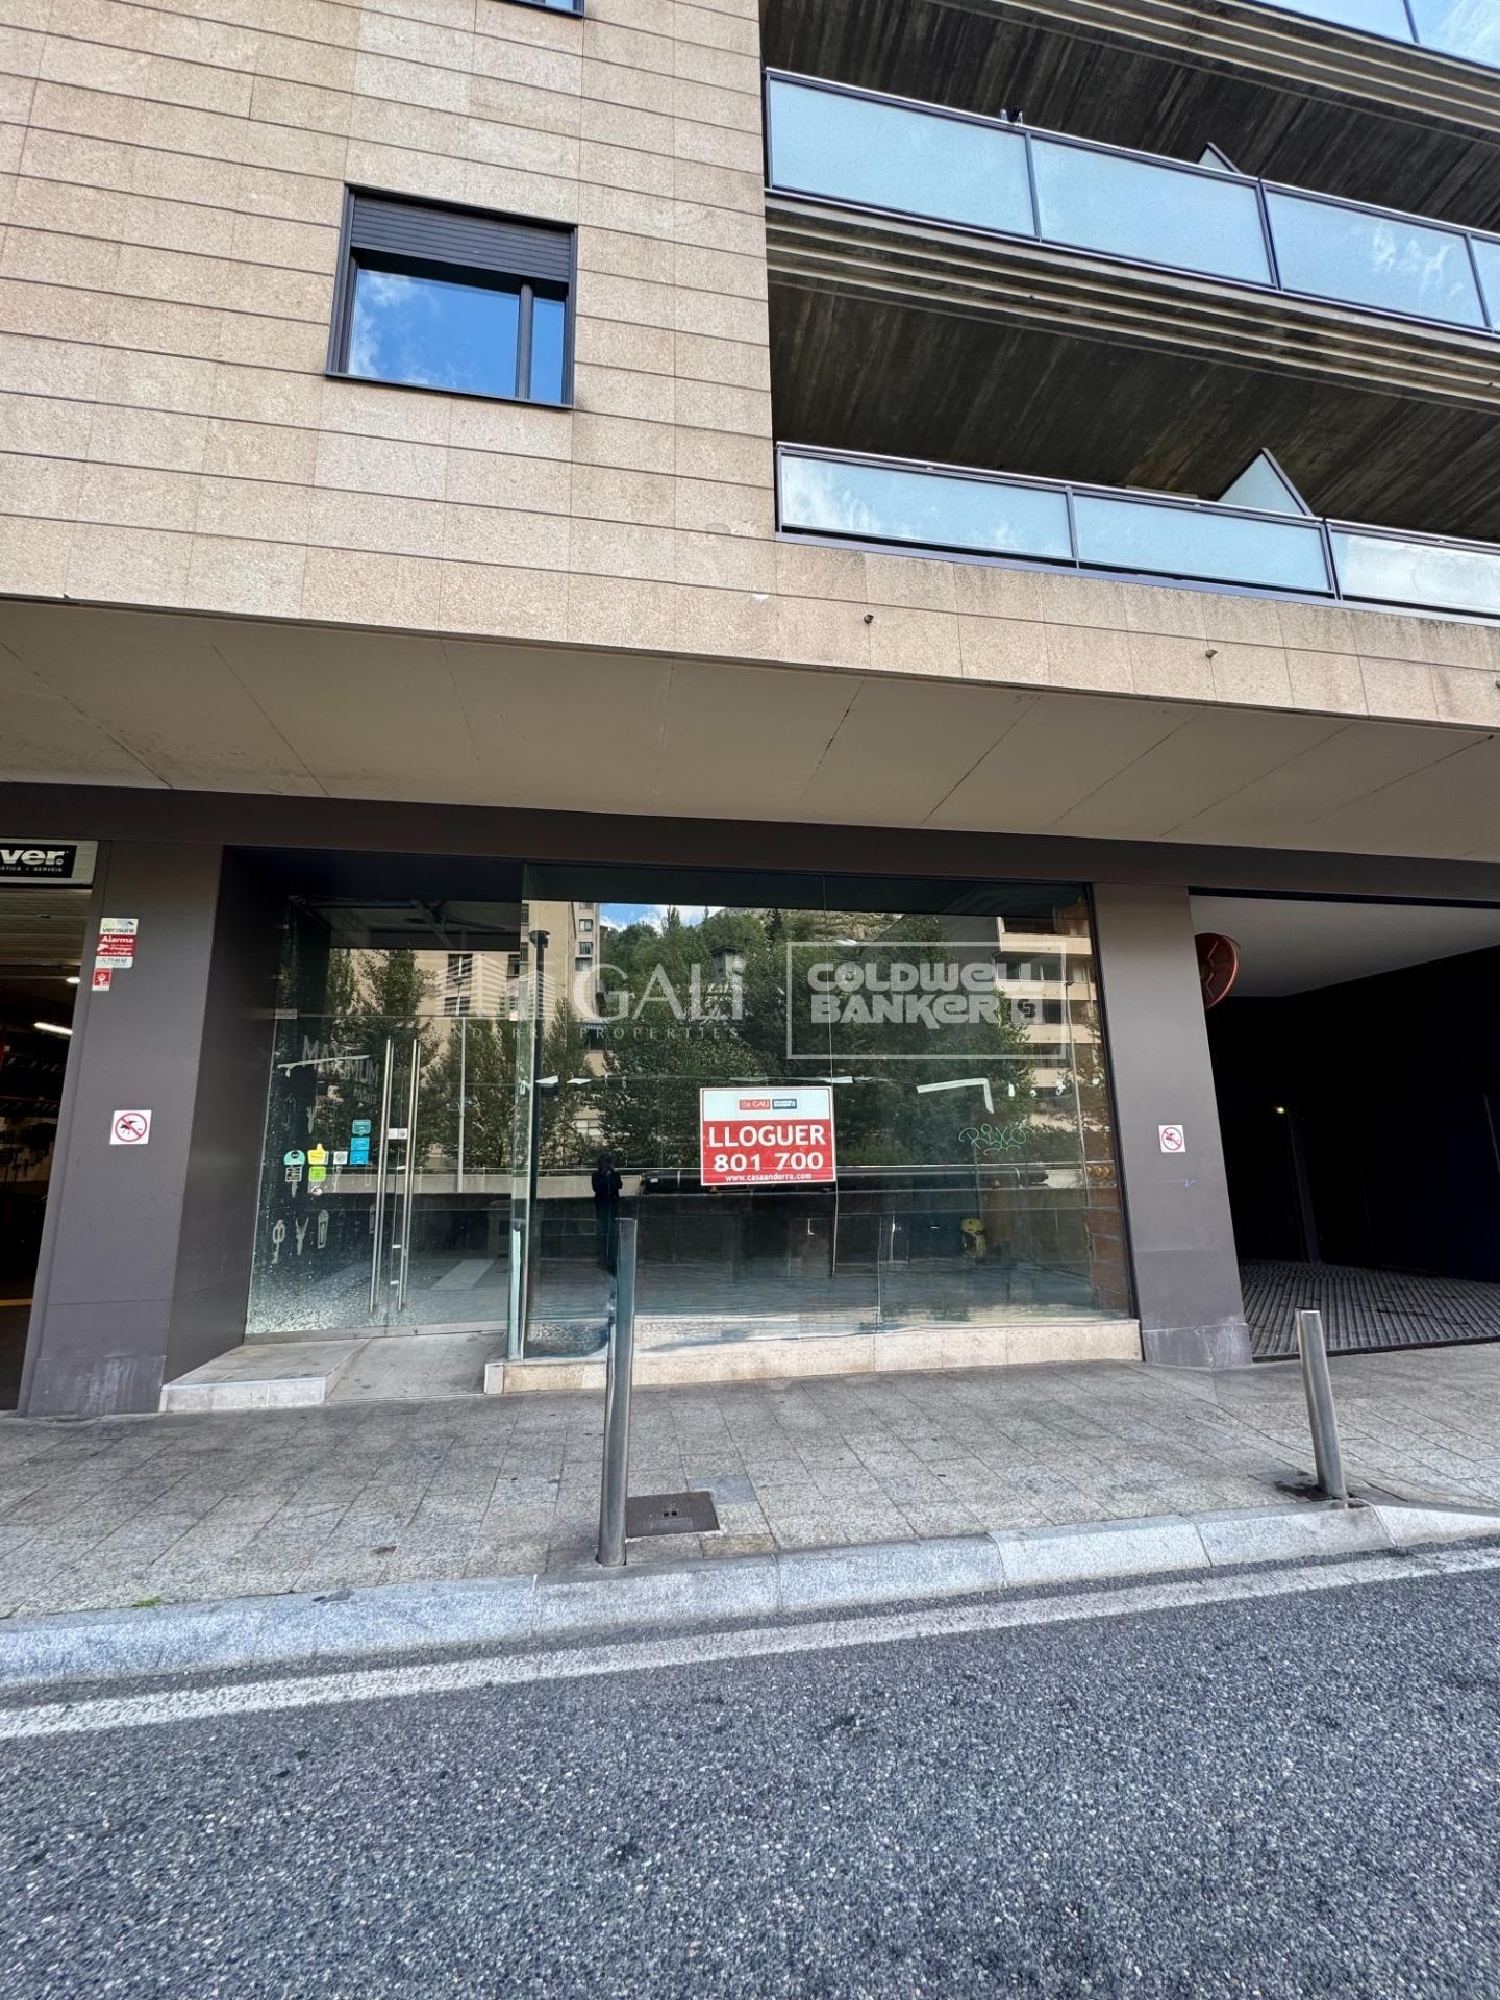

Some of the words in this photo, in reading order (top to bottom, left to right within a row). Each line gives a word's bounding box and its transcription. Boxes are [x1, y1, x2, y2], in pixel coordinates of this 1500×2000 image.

[101, 936, 134, 944] Alarma
[708, 1124, 826, 1148] LLOGUER
[714, 1153, 761, 1172] 801
[774, 1151, 824, 1171] 700
[724, 1172, 812, 1182] www.casaandorra.com
